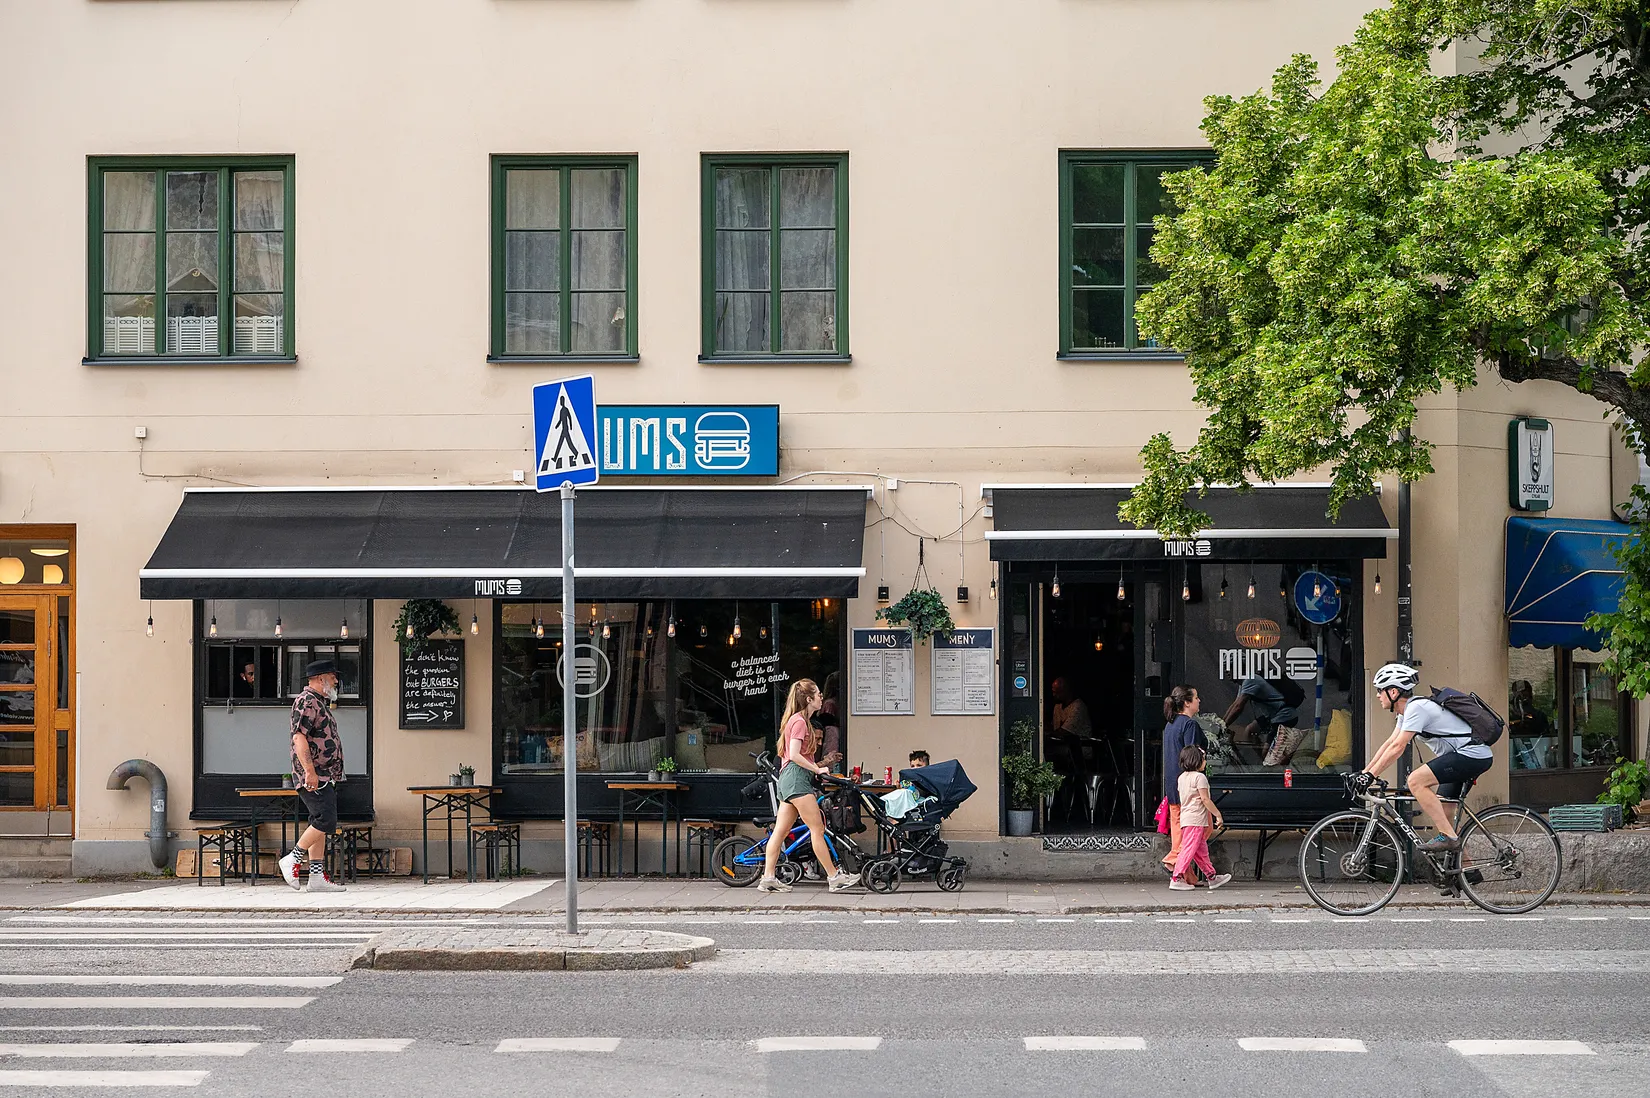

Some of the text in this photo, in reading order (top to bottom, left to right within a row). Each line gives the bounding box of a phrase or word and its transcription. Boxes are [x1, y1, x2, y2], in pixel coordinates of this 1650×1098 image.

[604, 417, 686, 470] UMS
[1522, 483, 1549, 494] SKEPPSHULT
[1164, 541, 1195, 556] MUMS
[475, 580, 505, 595] MUMS
[868, 634, 897, 648] MUMS
[949, 632, 975, 645] MENY
[437, 649, 459, 661] know
[731, 652, 780, 668] a balanced
[405, 664, 419, 675] the
[735, 665, 775, 677] diet is a
[1219, 649, 1281, 680] MUMS
[405, 677, 459, 688] but BURGERS
[723, 670, 790, 690] burger in each
[744, 684, 768, 696] hand
[405, 689, 456, 705] are definitely
[405, 701, 420, 709] the
